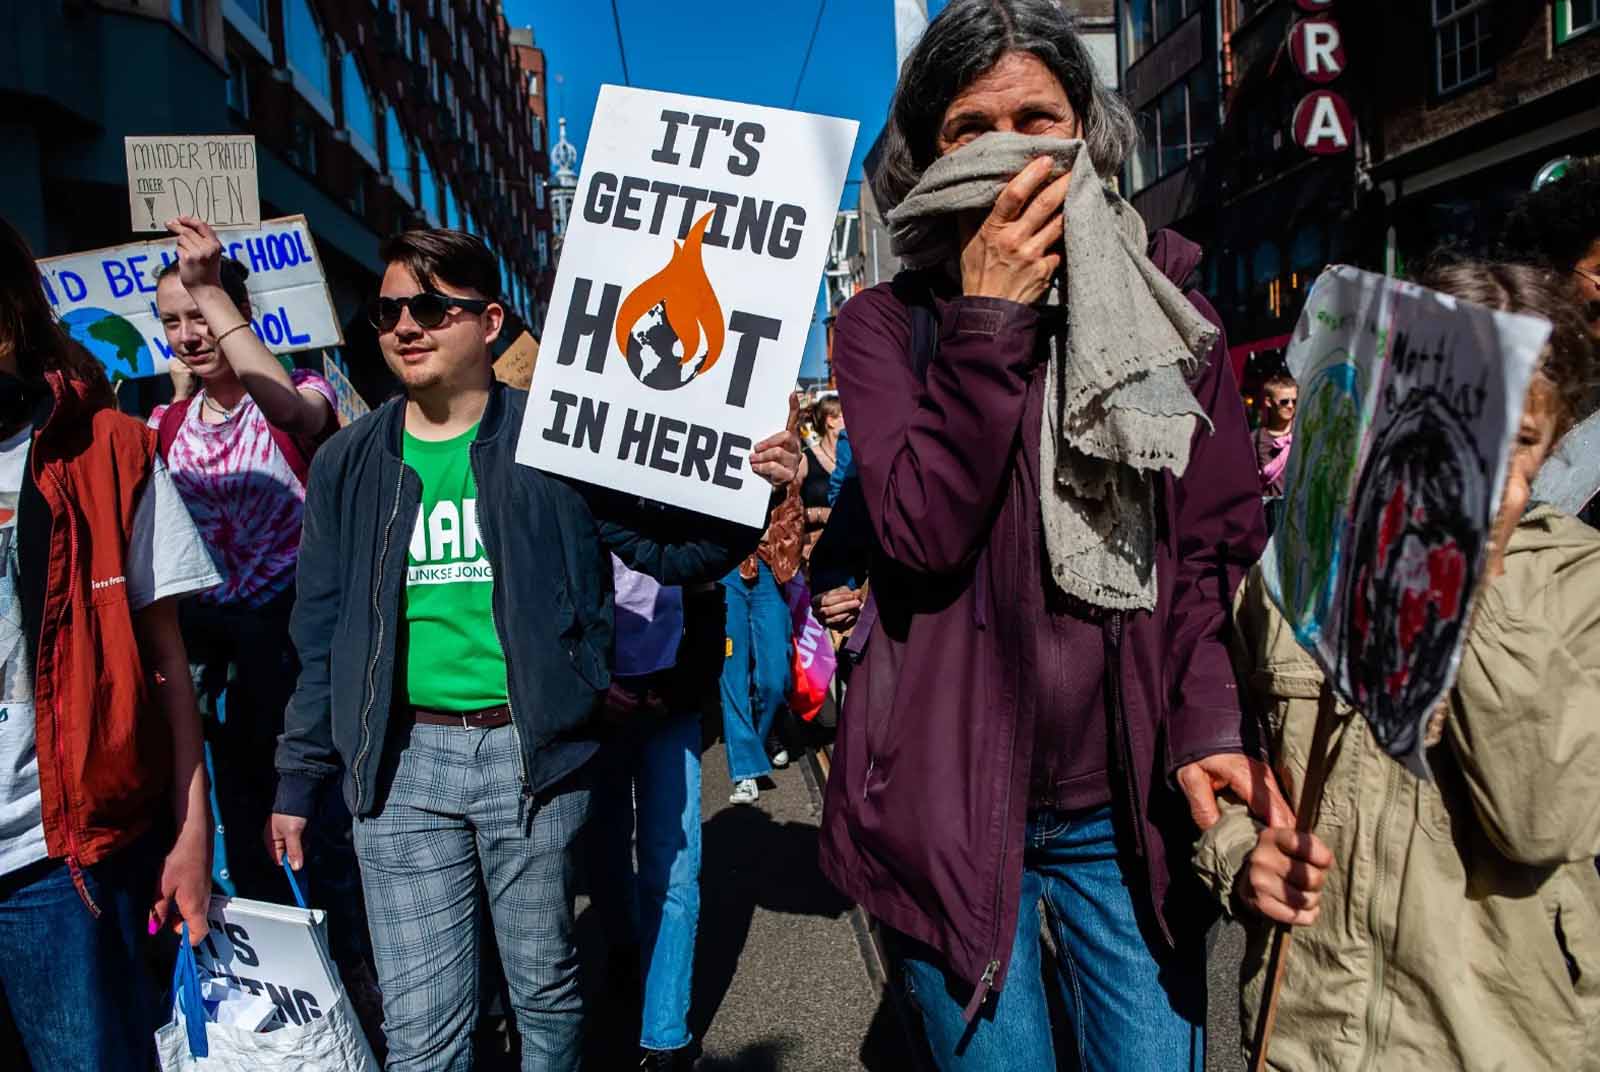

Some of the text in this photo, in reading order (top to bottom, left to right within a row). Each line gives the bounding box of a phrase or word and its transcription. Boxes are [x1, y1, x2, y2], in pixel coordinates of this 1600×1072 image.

[1303, 0, 1348, 147] RA
[651, 109, 765, 177] IT'S
[168, 176, 244, 224] DOEN
[583, 171, 807, 260] GETTING
[102, 255, 157, 298] BE
[221, 230, 312, 273] CHOOL
[542, 388, 752, 490] IN HERE
